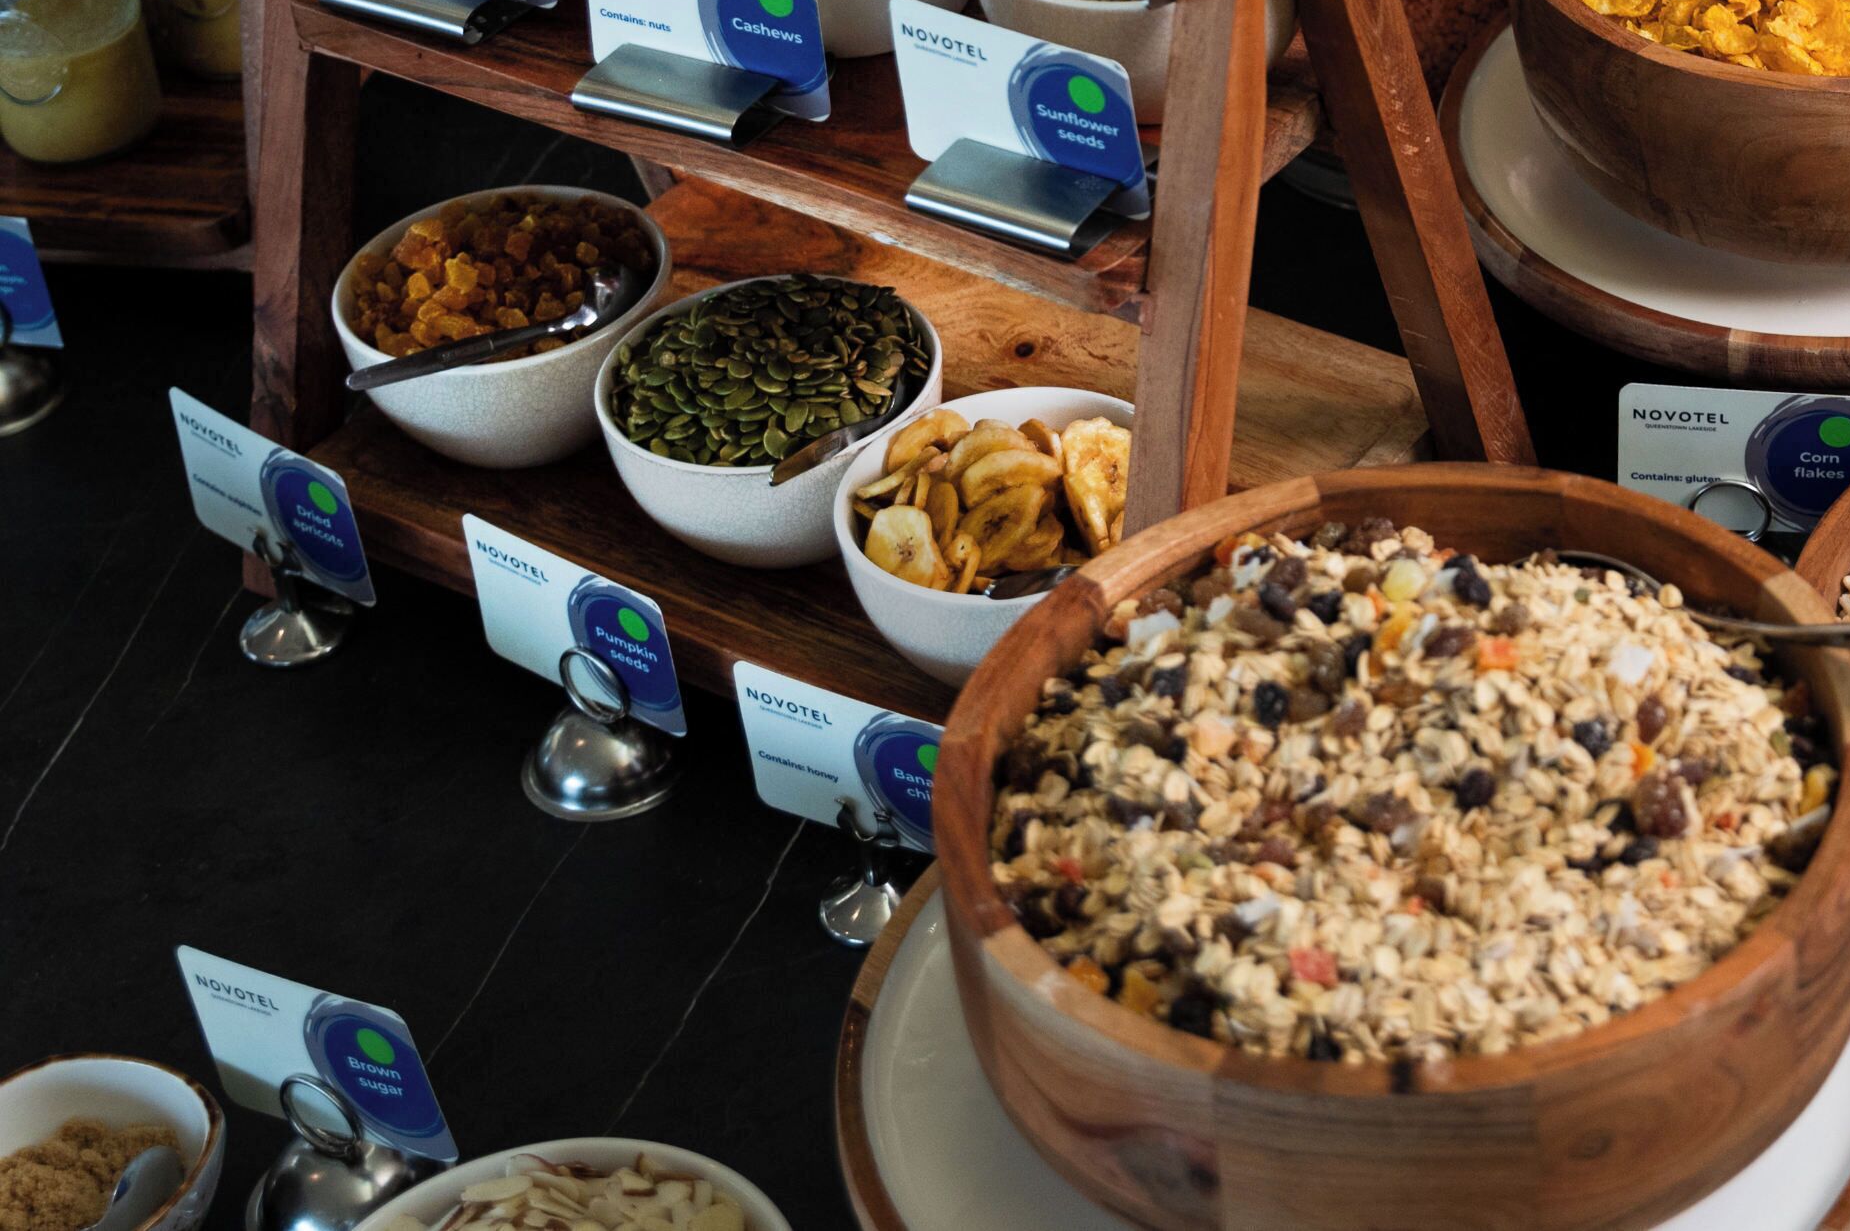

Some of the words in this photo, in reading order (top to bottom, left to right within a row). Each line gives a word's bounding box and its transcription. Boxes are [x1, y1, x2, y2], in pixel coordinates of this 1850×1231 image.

[599, 8, 647, 27] Contains:
[648, 20, 672, 32] nuts
[732, 17, 803, 44] Cashews
[901, 23, 987, 61] NOVOTEL
[1035, 103, 1120, 137] Sunflower
[1058, 128, 1105, 150] seeds
[1633, 408, 1729, 425] NOVOTEL
[180, 412, 243, 456] NOVOTEL
[1800, 451, 1839, 464] Corn
[1631, 472, 1682, 482] Contains:
[1794, 467, 1845, 480] flakes
[296, 504, 331, 528] Dried
[293, 519, 344, 548] apricots
[476, 540, 549, 582] NOVOTEL
[596, 626, 657, 663] Pumpkin
[610, 649, 650, 673] seeds
[746, 687, 832, 725] NOVOTEL
[806, 765, 839, 784] honey
[893, 767, 934, 788] Bana
[907, 788, 932, 801] chi
[195, 974, 279, 1011] NOVOTEL
[347, 1056, 401, 1080] Brown
[359, 1075, 403, 1096] sugar
